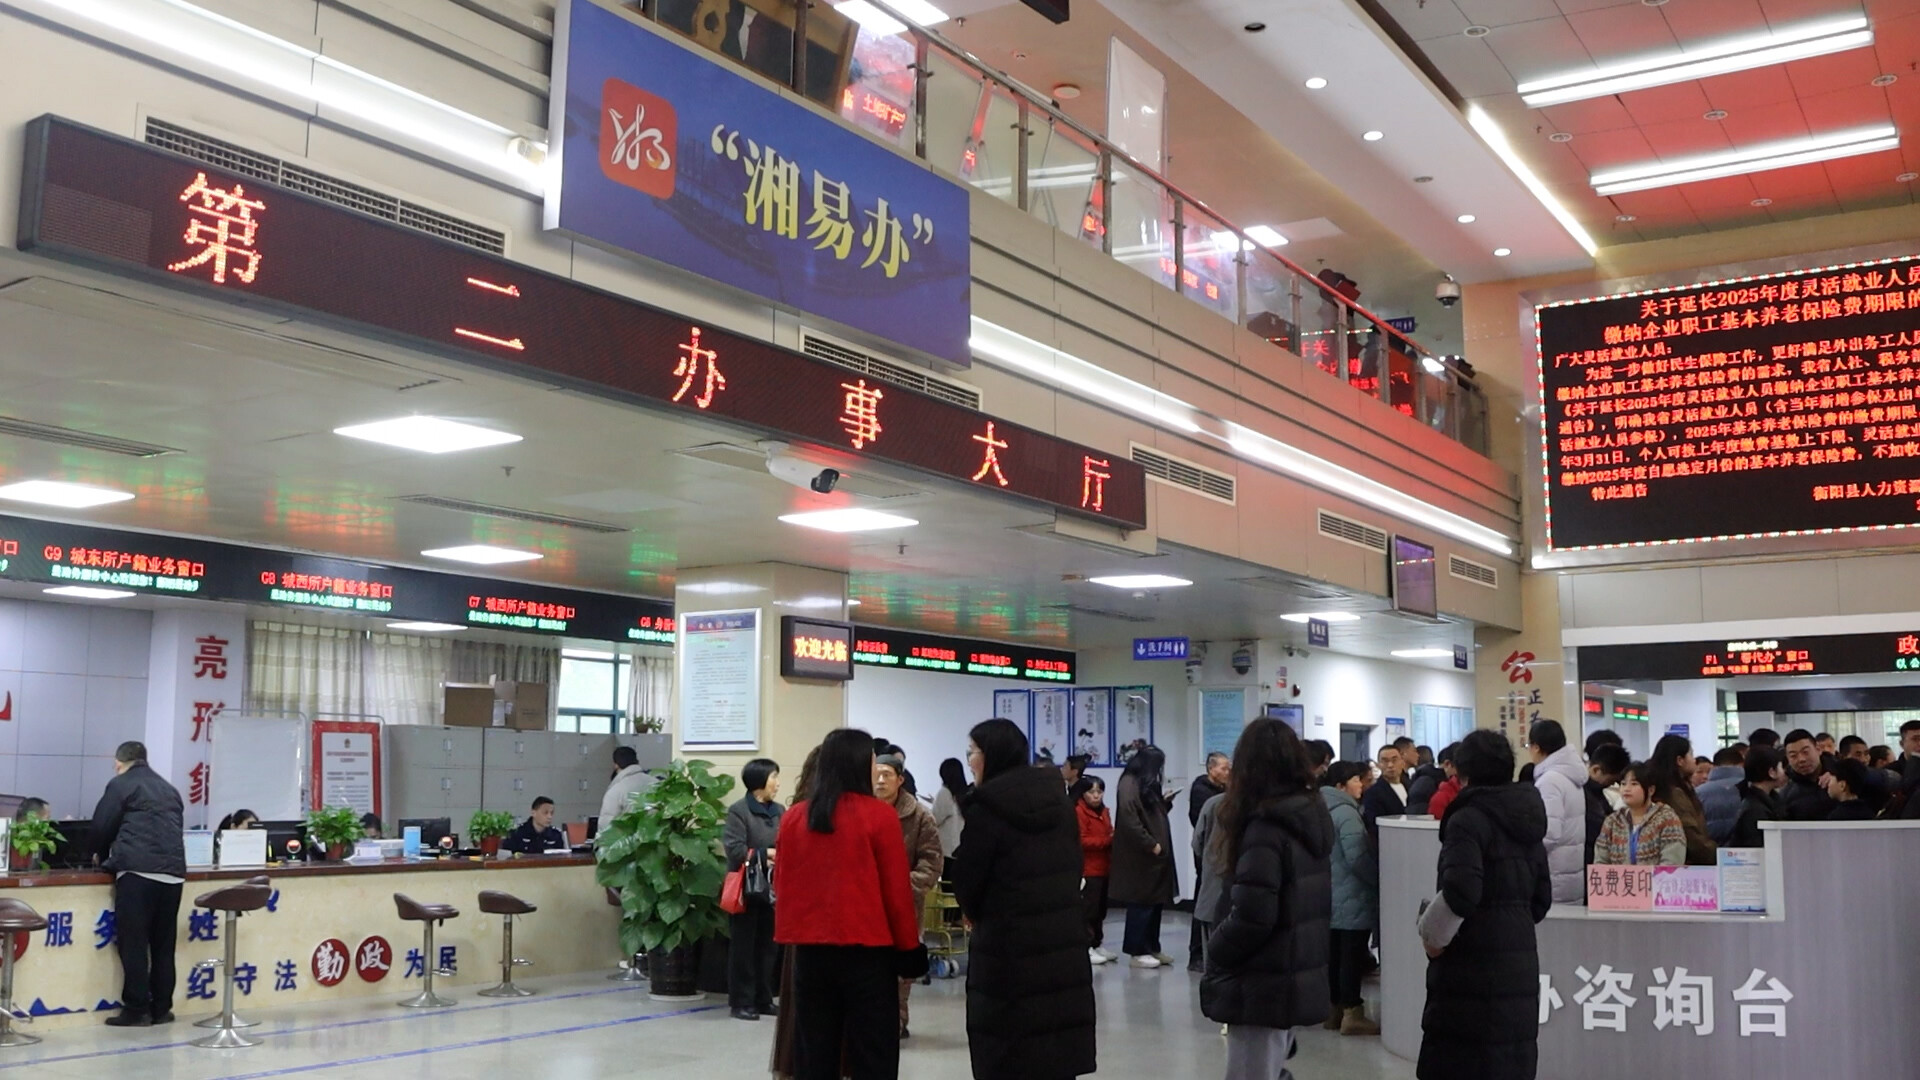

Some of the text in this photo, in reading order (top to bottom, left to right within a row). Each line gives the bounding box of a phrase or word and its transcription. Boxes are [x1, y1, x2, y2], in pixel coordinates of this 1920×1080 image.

[711, 124, 933, 278] “湘易办”
[1640, 266, 1920, 319] 关于延长2025年度灵活就业人员
[1603, 290, 1920, 345] 缴纳企业职工基本养老保险费期限的
[1591, 483, 1648, 500] 特此通告
[44, 545, 205, 577] G9 城东所户籍业务窗口
[281, 573, 393, 598] 城西所户籍业务窗口
[793, 636, 848, 662] 欢迎光临
[1896, 634, 1920, 655] 政
[1500, 650, 1536, 684] 公
[1588, 867, 1652, 899] 免费复印
